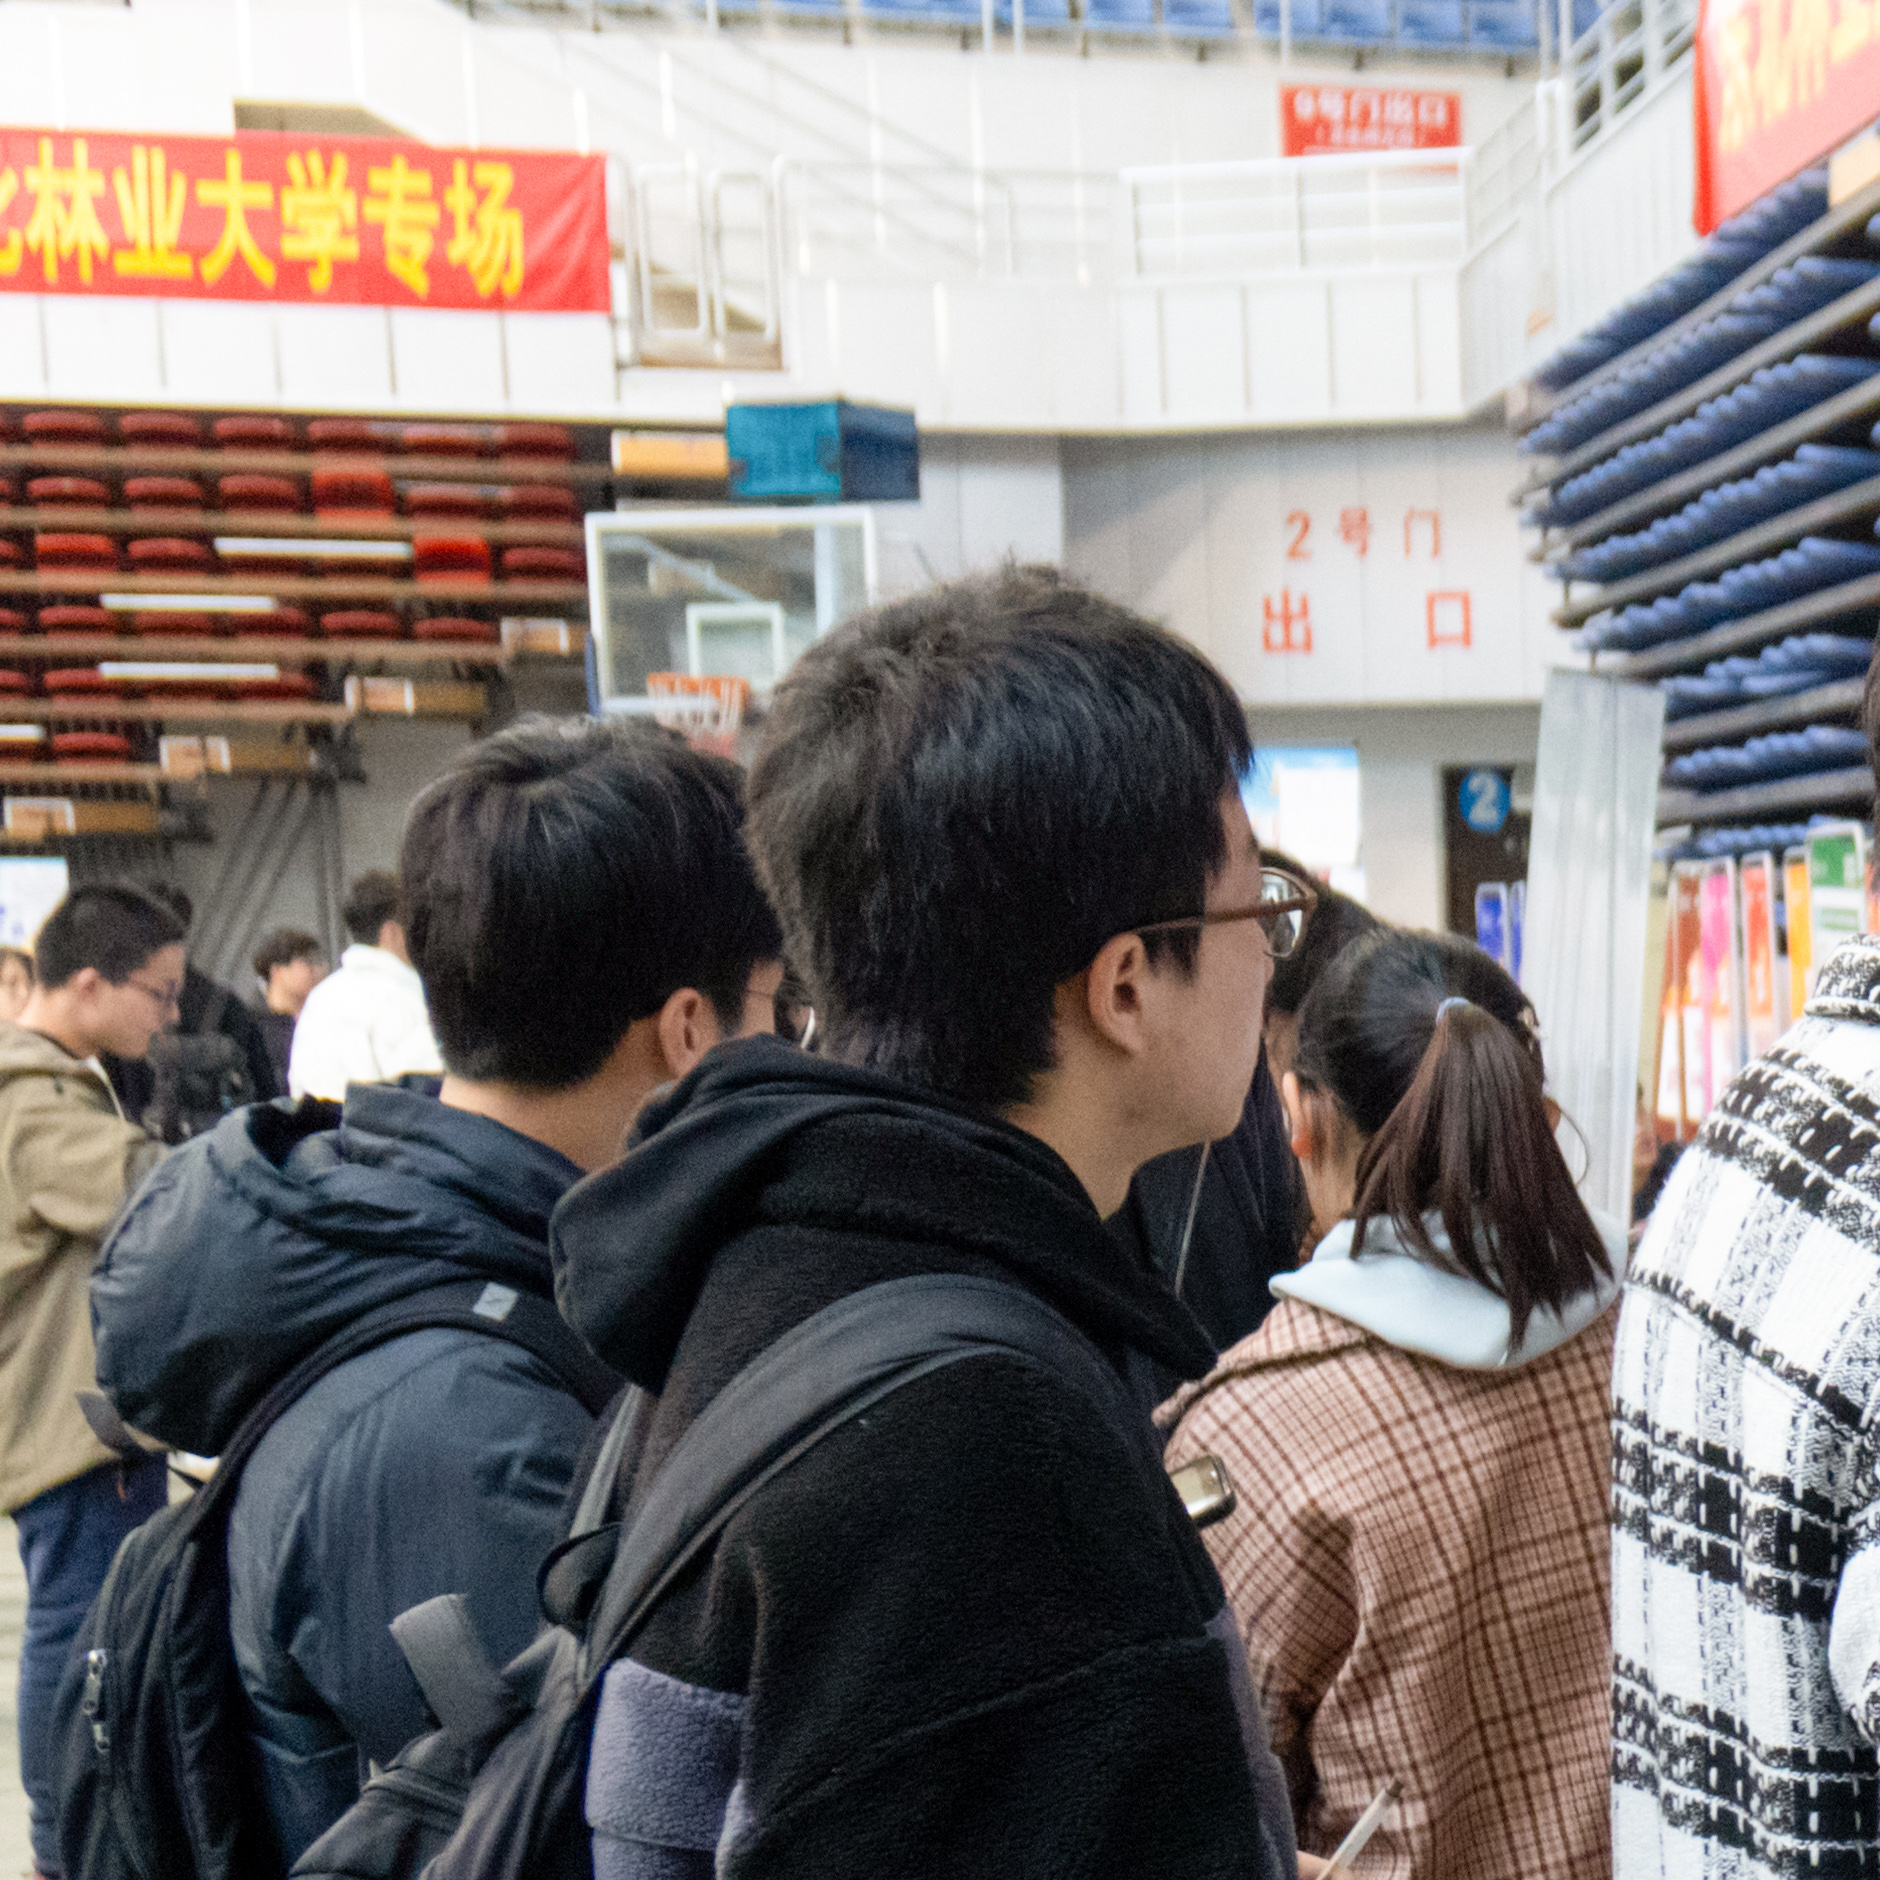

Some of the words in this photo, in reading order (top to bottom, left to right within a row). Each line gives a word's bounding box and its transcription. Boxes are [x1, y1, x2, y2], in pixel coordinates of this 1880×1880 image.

[0, 137, 526, 299] 林业大学专场
[1286, 506, 1441, 558] 2号门
[1263, 586, 1472, 653] 出口
[1467, 772, 1499, 824] 2
